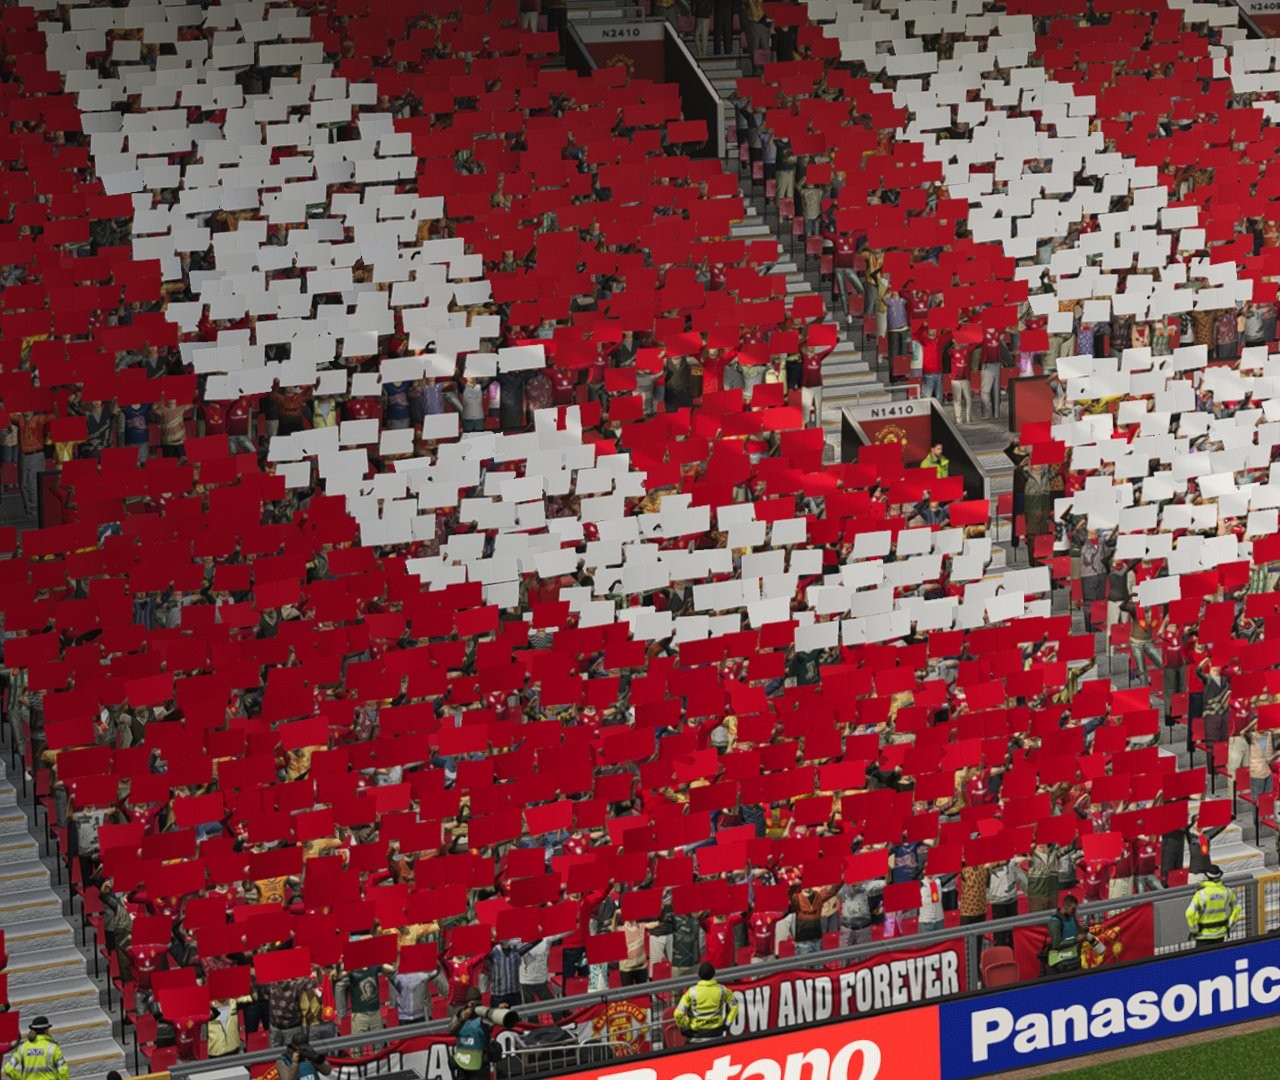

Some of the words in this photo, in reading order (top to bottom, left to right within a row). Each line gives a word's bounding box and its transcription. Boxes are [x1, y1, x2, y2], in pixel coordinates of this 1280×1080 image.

[602, 27, 640, 38] N2410
[871, 405, 913, 417] N1410
[724, 985, 771, 1037] OW
[777, 976, 833, 1027] AND
[839, 950, 960, 1017] FOREVER
